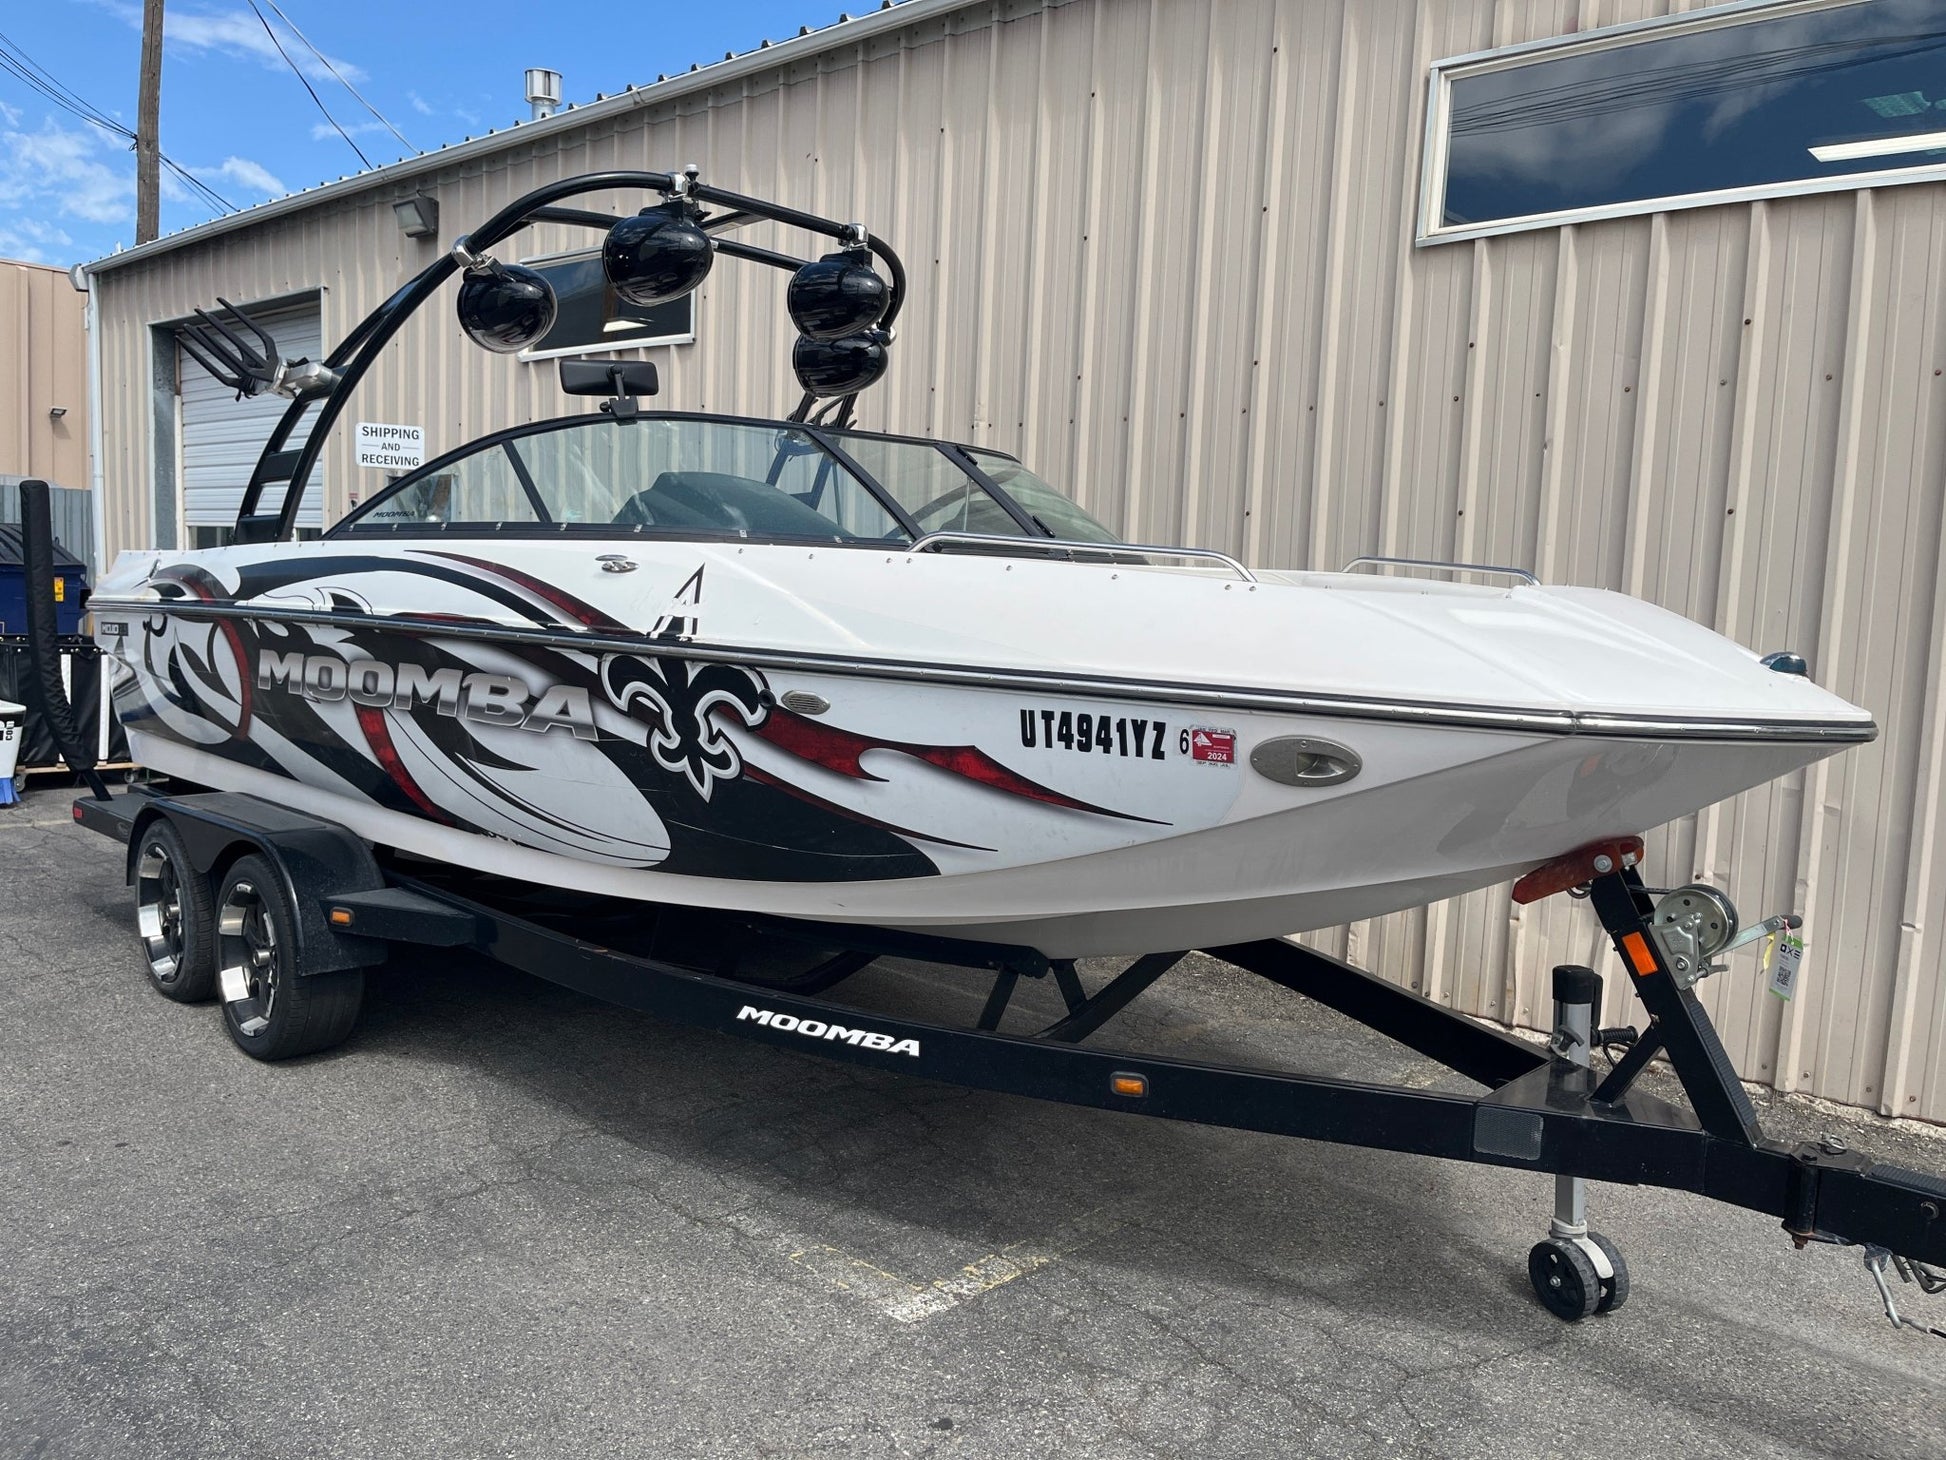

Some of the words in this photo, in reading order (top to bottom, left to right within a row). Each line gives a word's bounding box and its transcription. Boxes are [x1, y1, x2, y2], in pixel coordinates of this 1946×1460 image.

[361, 426, 420, 440] SHIPPING
[381, 442, 401, 452] AND
[361, 453, 420, 467] RECEIVING
[257, 649, 600, 742] MOOMBA
[1020, 709, 1167, 760] UT4941YZ
[1179, 729, 1190, 754] 6
[1207, 751, 1227, 761] 2024
[736, 1005, 920, 1058] MOOMBA
